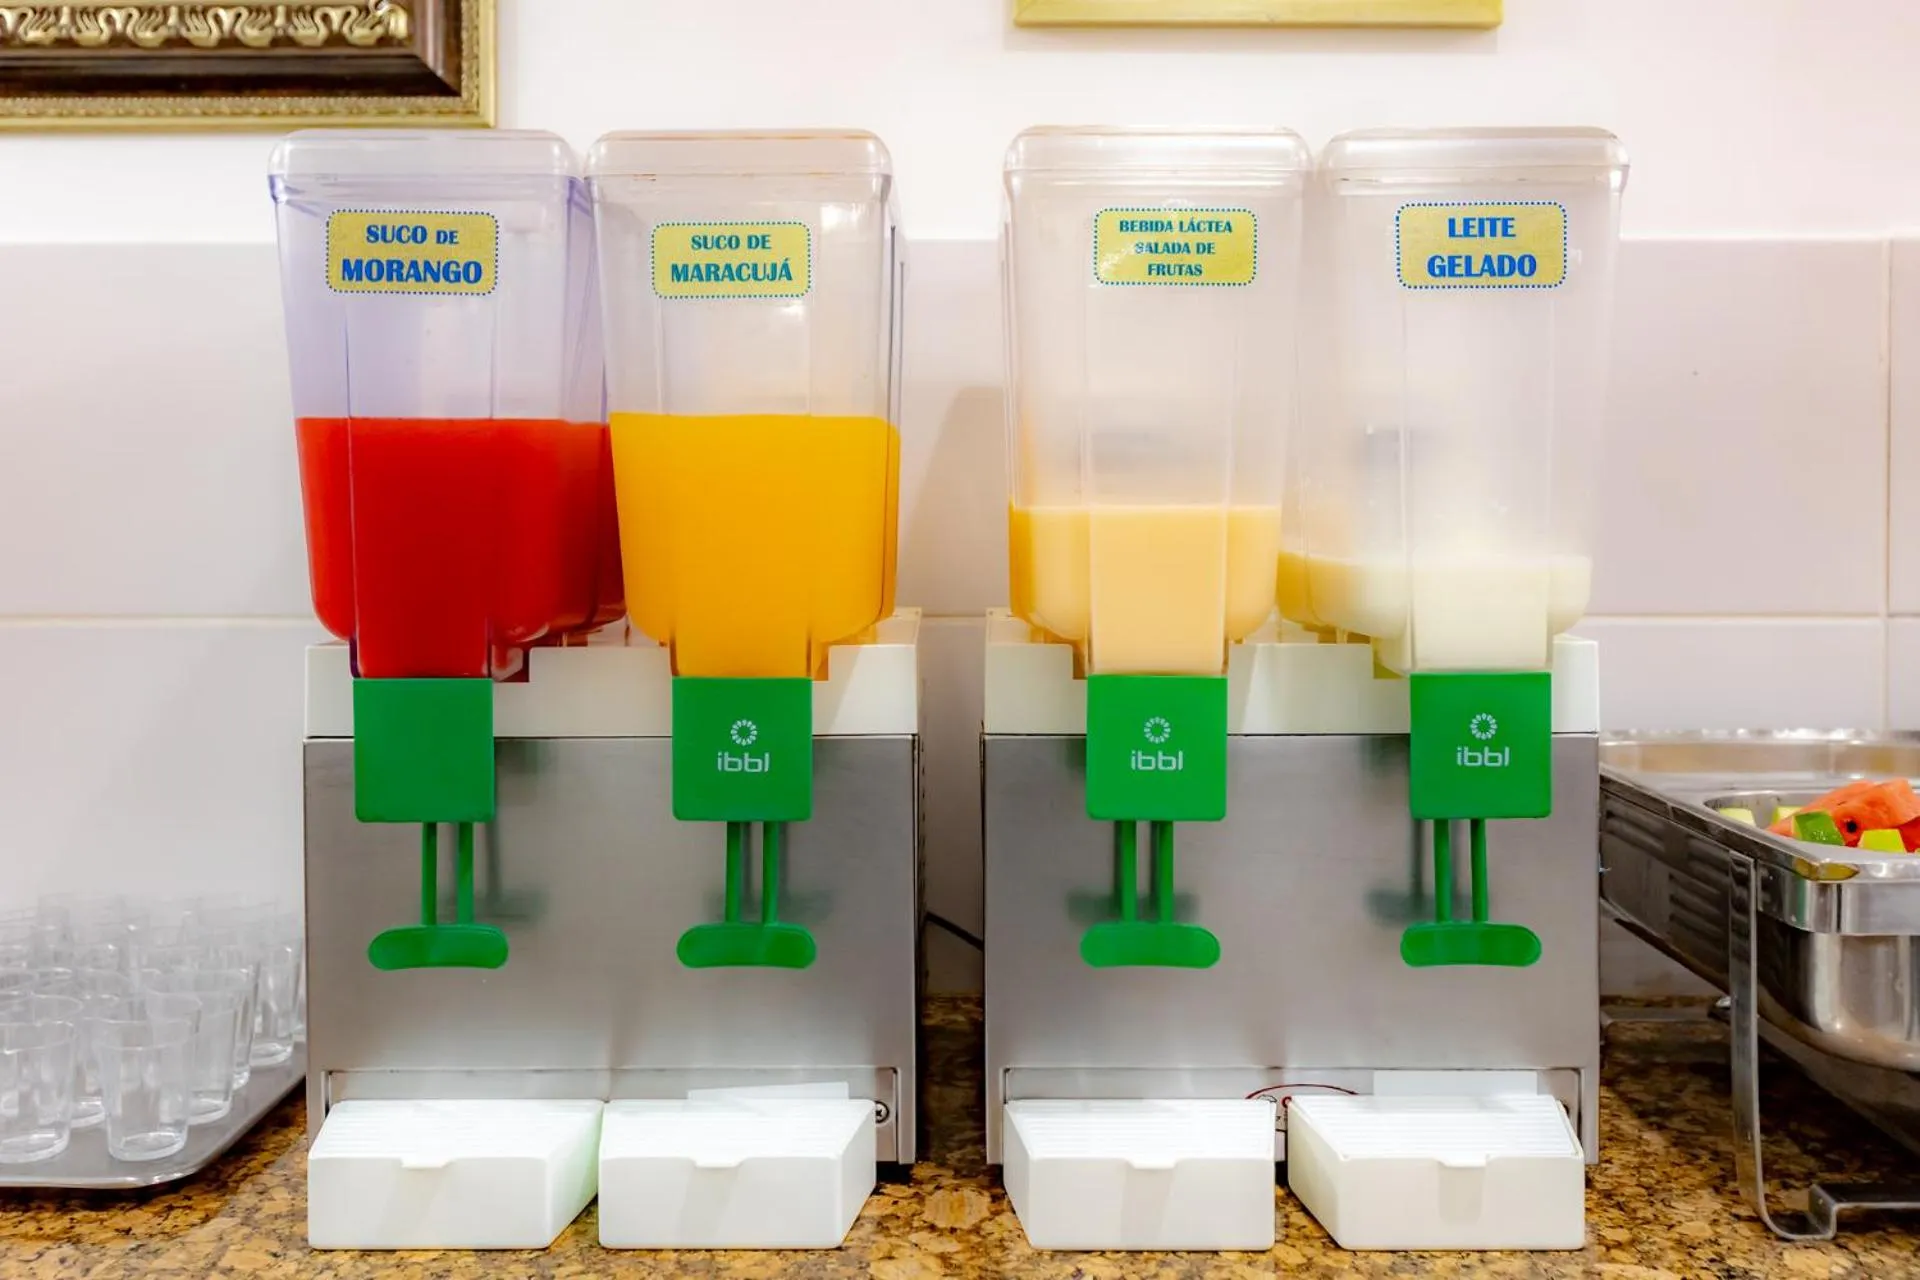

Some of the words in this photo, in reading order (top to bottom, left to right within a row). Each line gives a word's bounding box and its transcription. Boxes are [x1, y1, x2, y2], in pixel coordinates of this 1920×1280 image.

[366, 225, 428, 244] SUCO
[436, 230, 459, 245] DE
[1119, 219, 1173, 233] BEBIDA
[1178, 217, 1233, 233] LÁCTEA
[1448, 217, 1516, 238] LEITE
[691, 235, 740, 250] SUCO
[747, 235, 772, 250] DE
[1135, 242, 1191, 255] SALADA
[1196, 242, 1216, 254] DE
[341, 258, 483, 284] MORANGO
[671, 257, 793, 282] MARACUJÁ
[1147, 264, 1203, 277] FRUTAS
[1427, 254, 1537, 278] GELADO
[717, 752, 769, 773] ibbl
[1131, 750, 1183, 770] ibbl
[1457, 746, 1509, 767] ibbl
